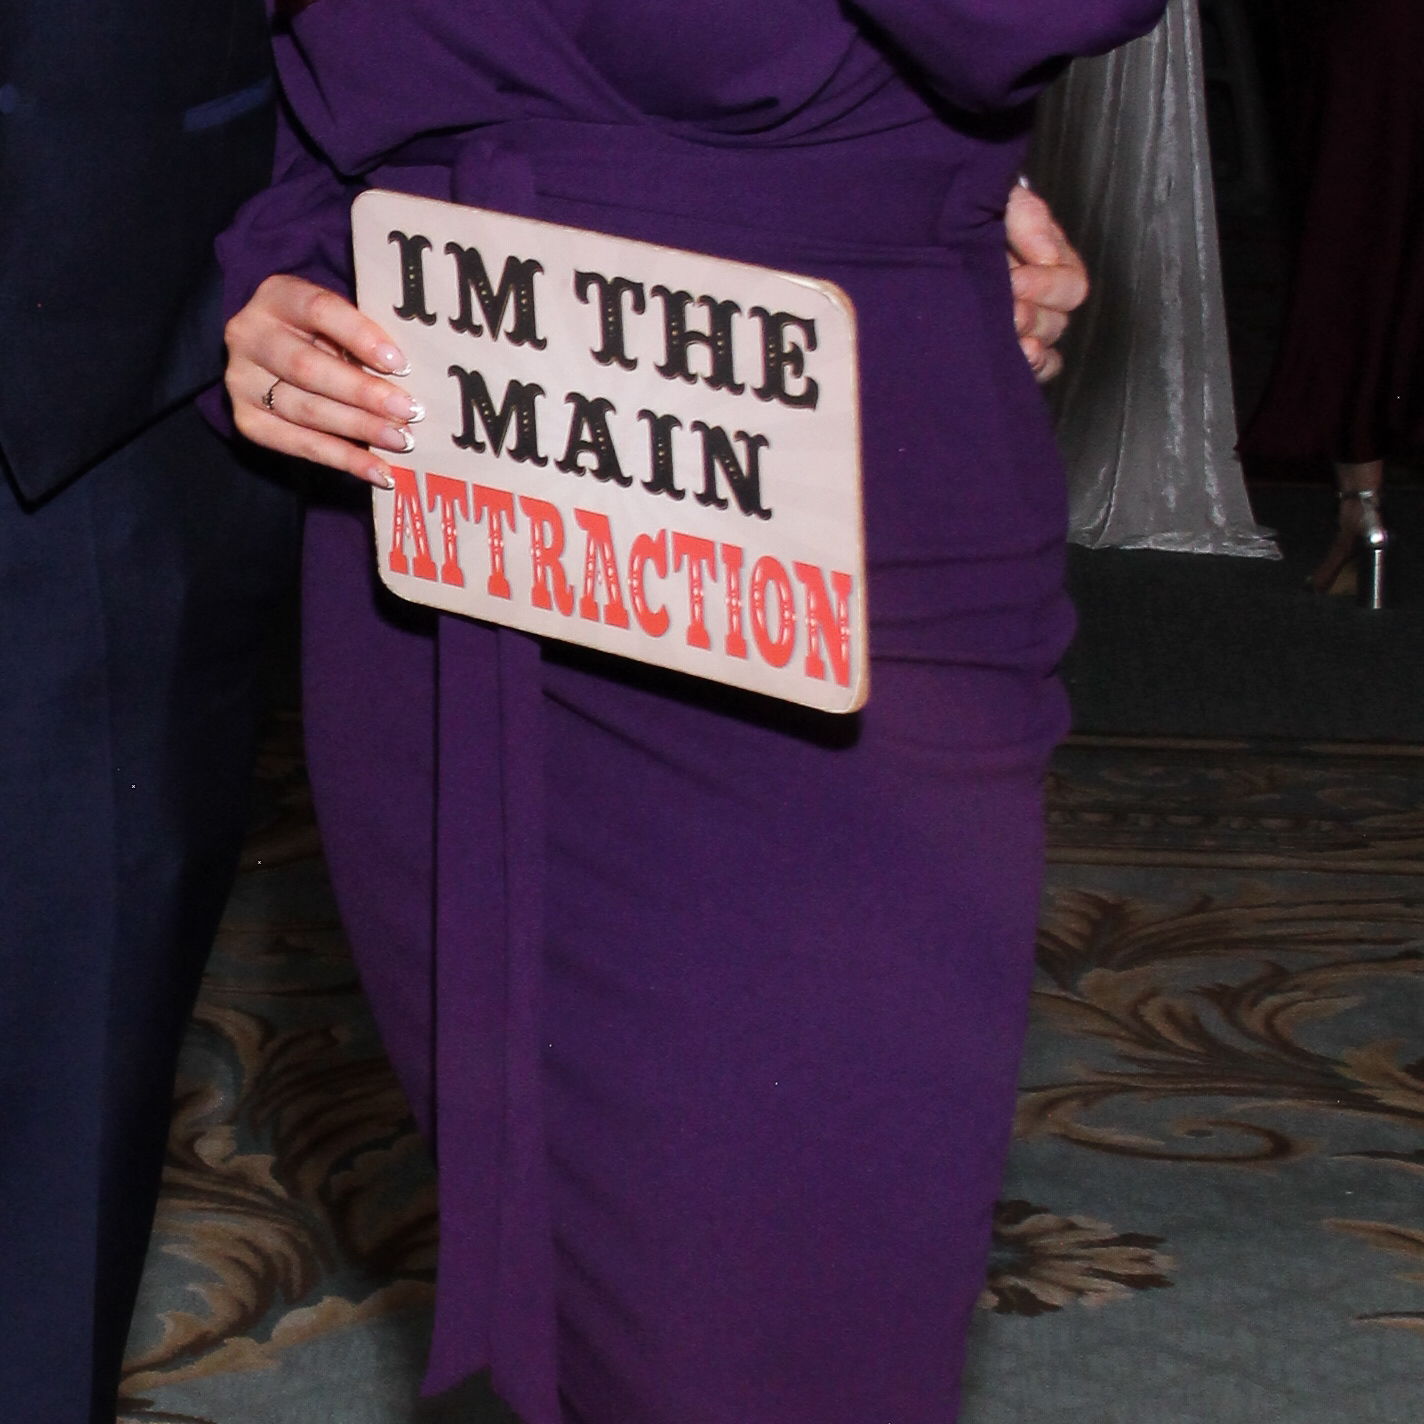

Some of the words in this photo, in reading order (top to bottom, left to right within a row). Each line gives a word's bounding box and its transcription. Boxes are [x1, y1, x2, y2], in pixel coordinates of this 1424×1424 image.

[387, 230, 548, 351] IM
[574, 269, 821, 411] THE
[447, 364, 772, 520] MAIN
[388, 465, 852, 688] ATTRACTION
